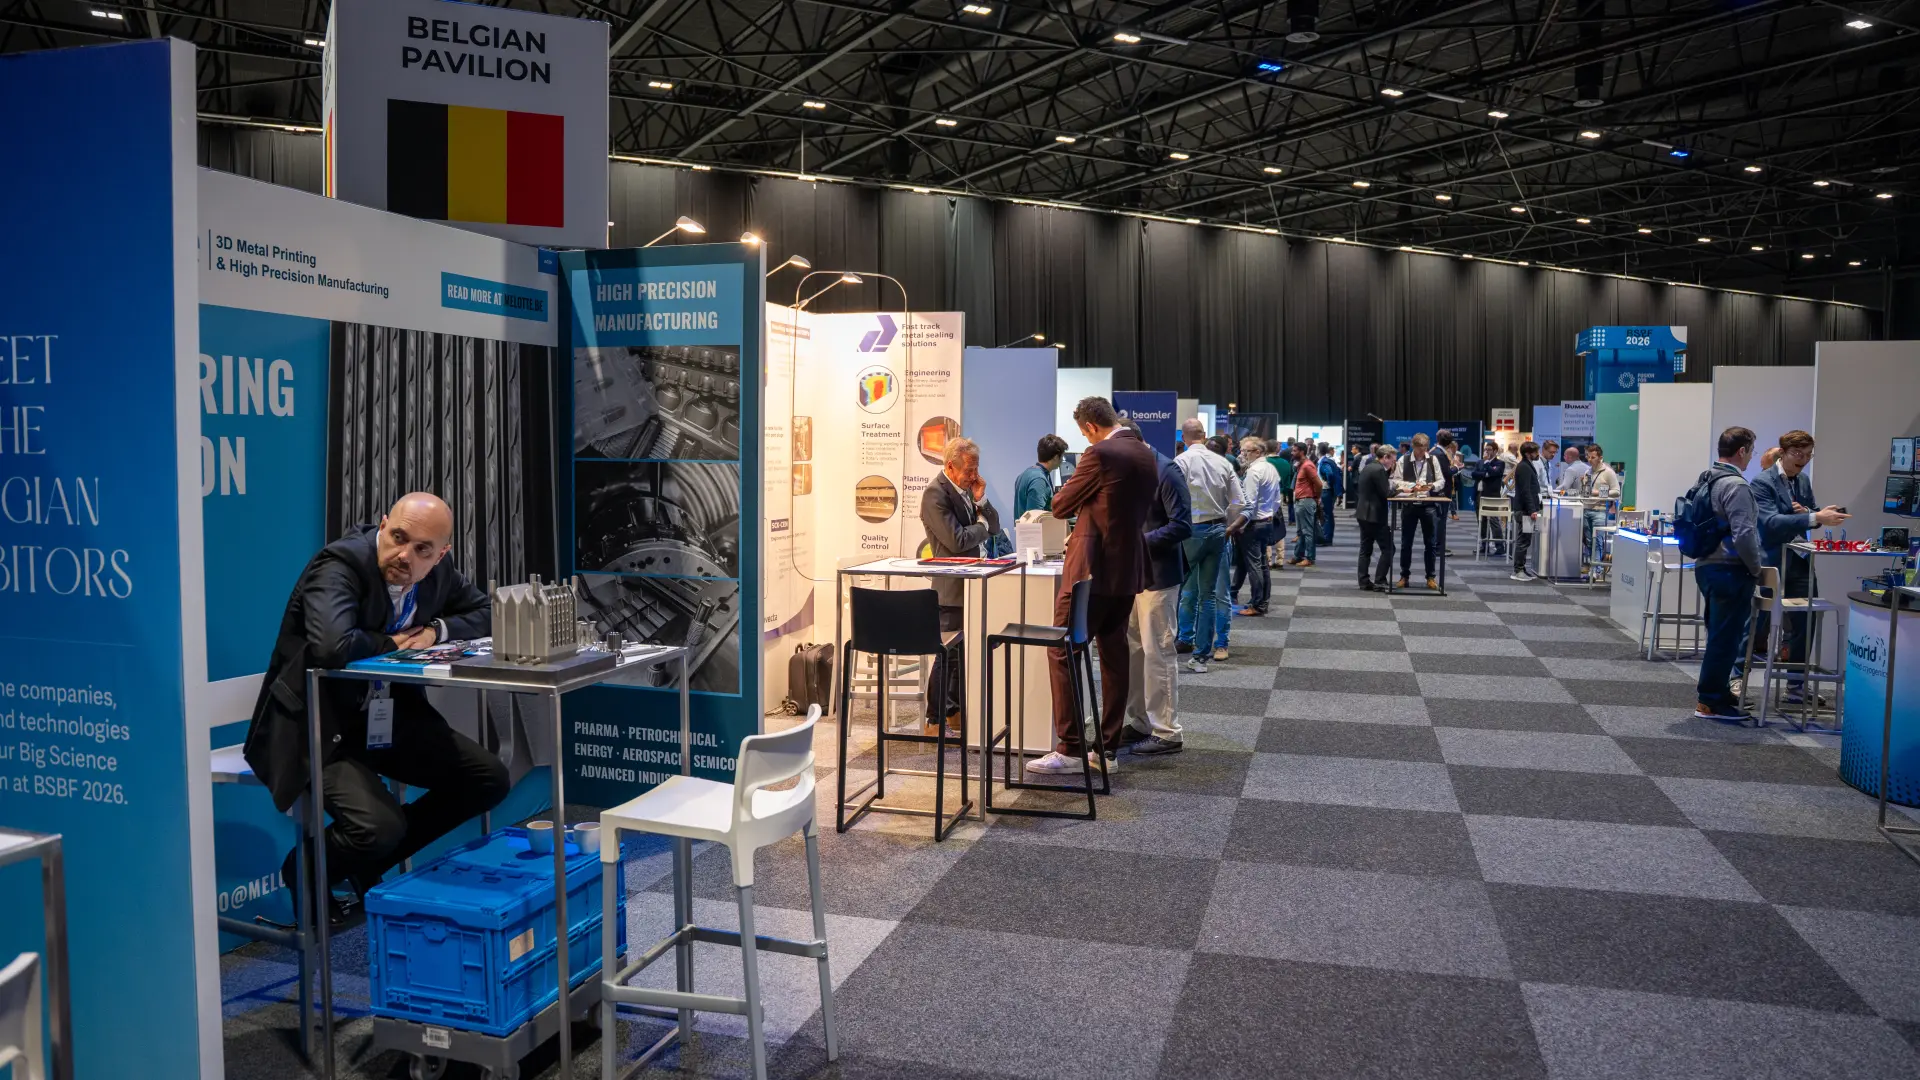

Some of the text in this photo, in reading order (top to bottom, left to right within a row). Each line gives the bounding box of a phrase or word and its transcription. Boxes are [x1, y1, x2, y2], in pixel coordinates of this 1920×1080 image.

[408, 16, 546, 54] BELGIAN
[402, 46, 550, 84] PAVILION
[216, 235, 317, 268] 3D Metal Printing
[216, 256, 389, 299] & High Precision Manufacturing
[596, 280, 717, 302] HIGH PRECISION
[447, 284, 543, 312] READ MORE AT MELOTTE.BE
[595, 311, 718, 332] MANUFACTURING
[1626, 336, 1650, 346] 2026
[199, 353, 295, 417] RING
[905, 369, 951, 377] Engineering
[1132, 411, 1171, 419] beamler
[1, 476, 99, 526] GIAN
[861, 534, 888, 542] Quality
[1813, 540, 1866, 552] TOPIC
[20, 684, 117, 711] companies,
[19, 712, 130, 743] technologies
[574, 721, 718, 748] PHARMA PETROCHICAL
[20, 742, 46, 769] Big
[49, 745, 118, 772] Science
[574, 742, 614, 759] ENERGY
[580, 764, 635, 782] ADVANCED
[13, 775, 30, 794] at
[34, 774, 78, 798] BSBF
[82, 780, 129, 805] 2026.
